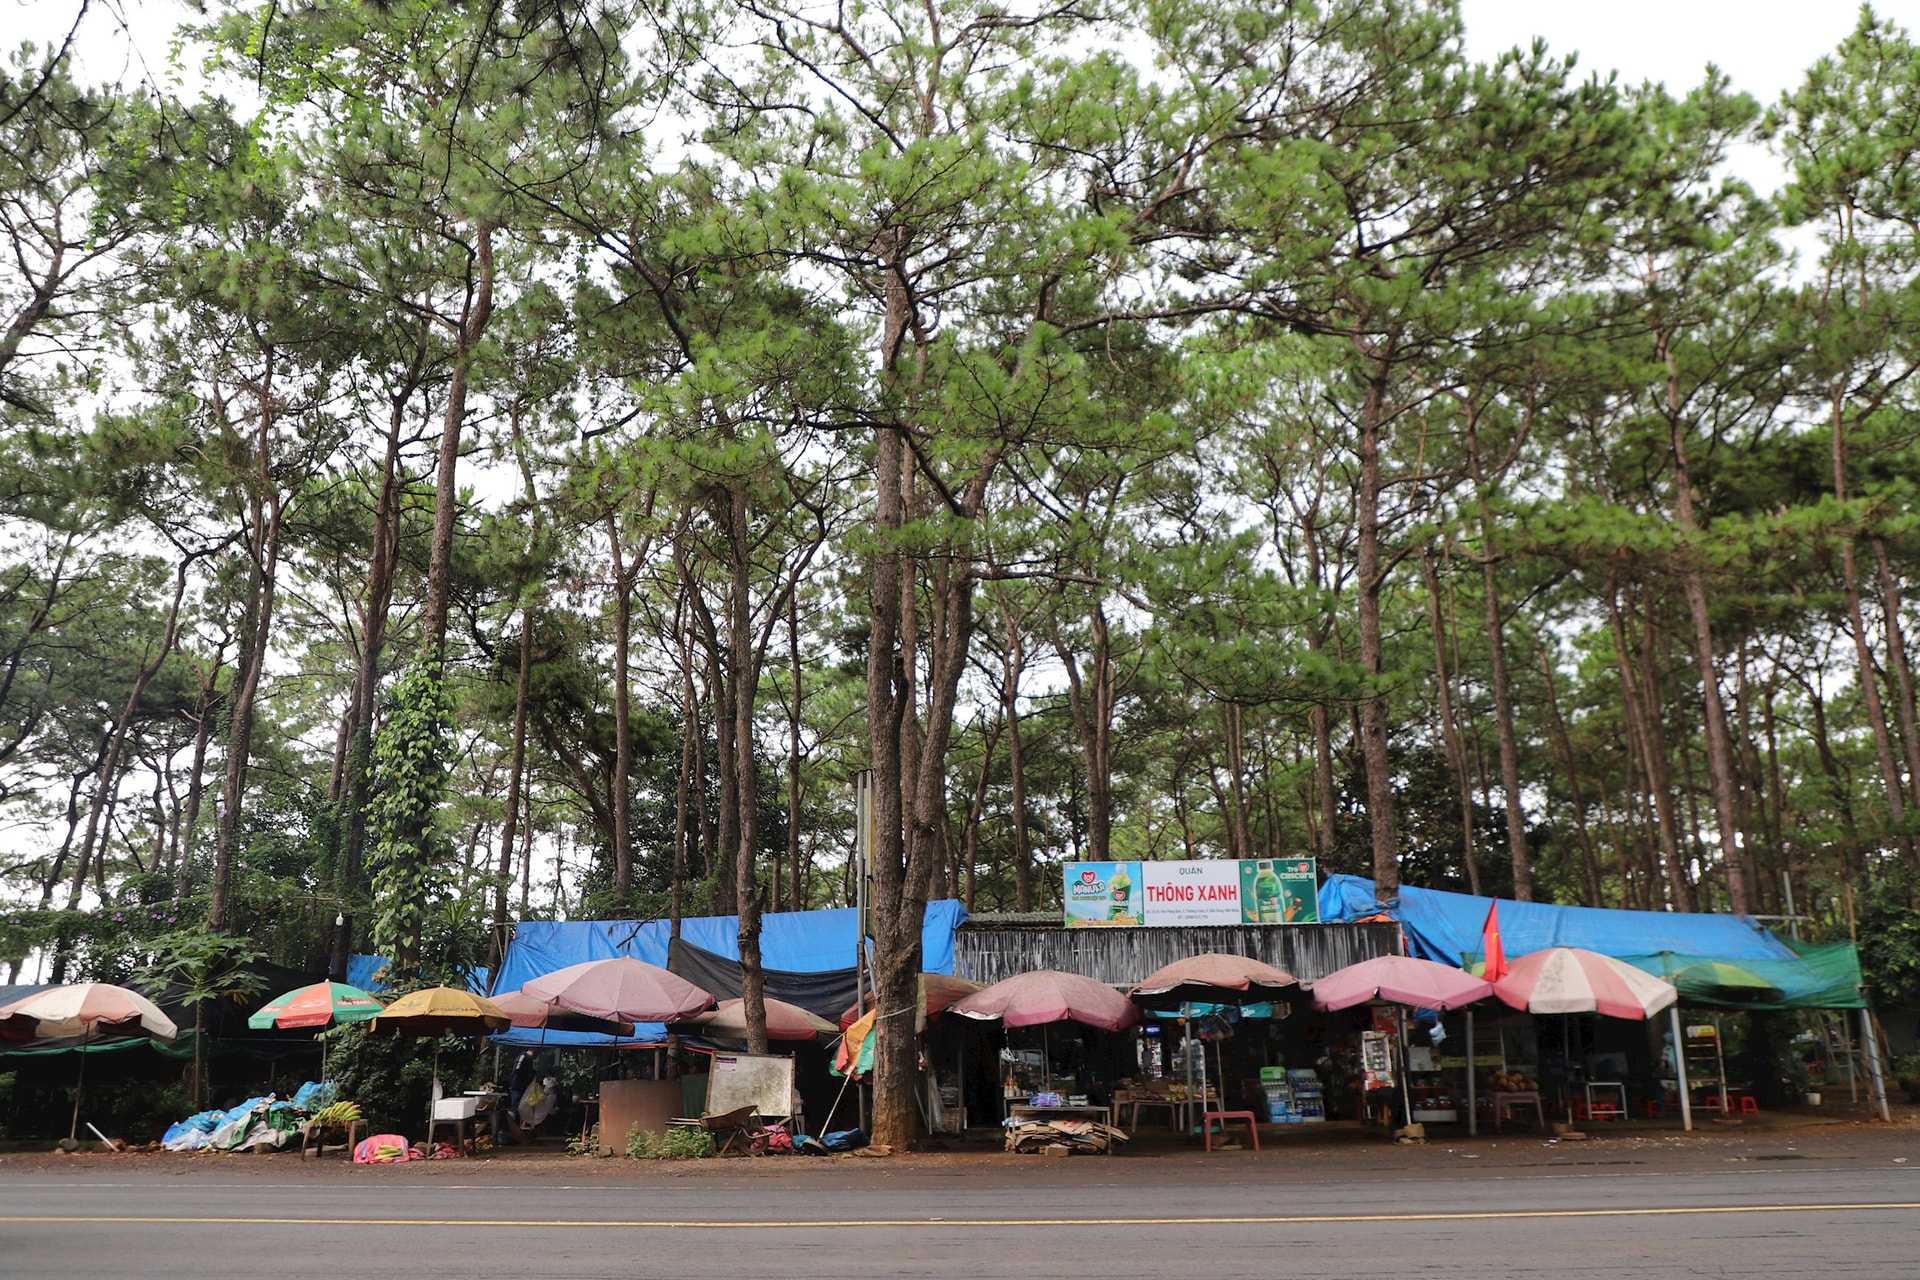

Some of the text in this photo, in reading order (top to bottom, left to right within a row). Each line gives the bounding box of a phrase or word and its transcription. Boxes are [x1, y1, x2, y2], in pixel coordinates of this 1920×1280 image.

[1179, 865, 1203, 875] QUÁN
[1073, 882, 1106, 895] MANUKA
[1146, 881, 1237, 902] THÔNG XANH
